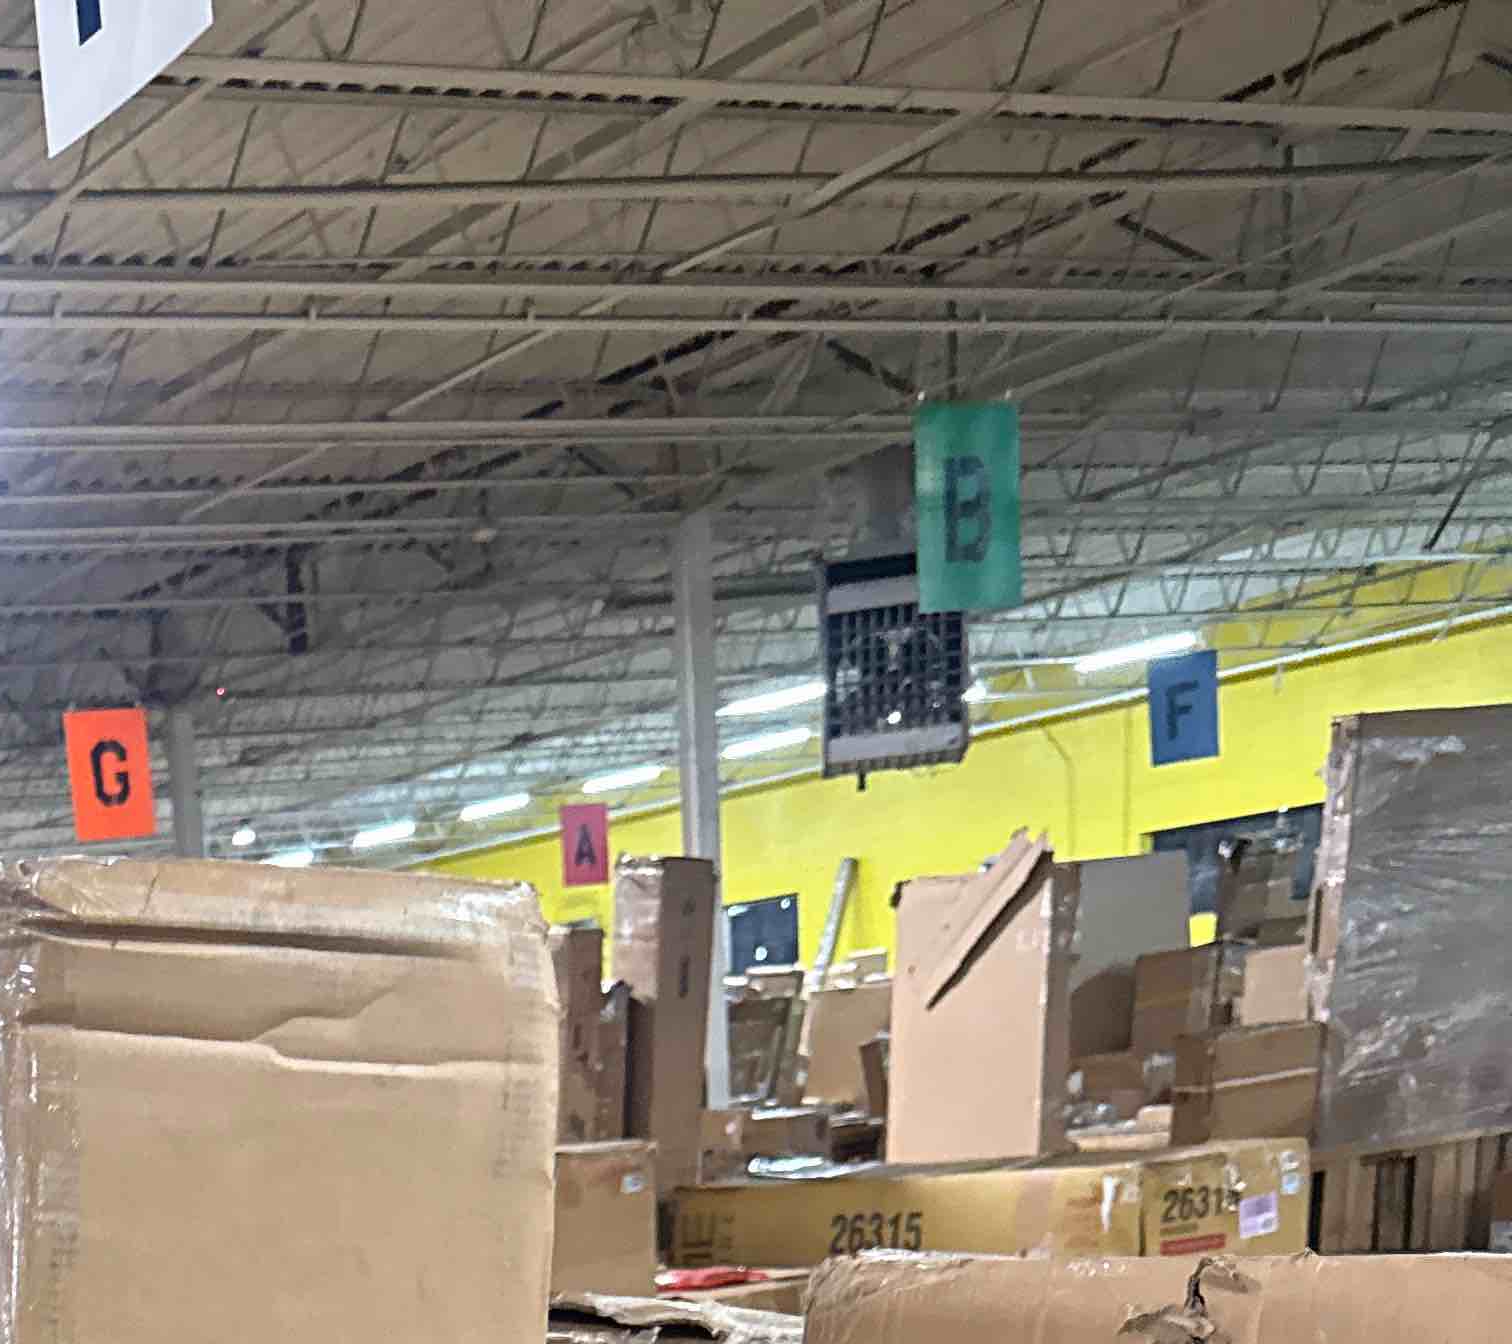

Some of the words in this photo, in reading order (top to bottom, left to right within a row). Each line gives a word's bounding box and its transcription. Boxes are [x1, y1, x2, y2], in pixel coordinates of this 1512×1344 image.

[945, 456, 988, 562] B
[1167, 679, 1199, 741] F
[91, 740, 130, 807] G
[574, 823, 597, 865] A
[830, 1212, 922, 1256] 26315
